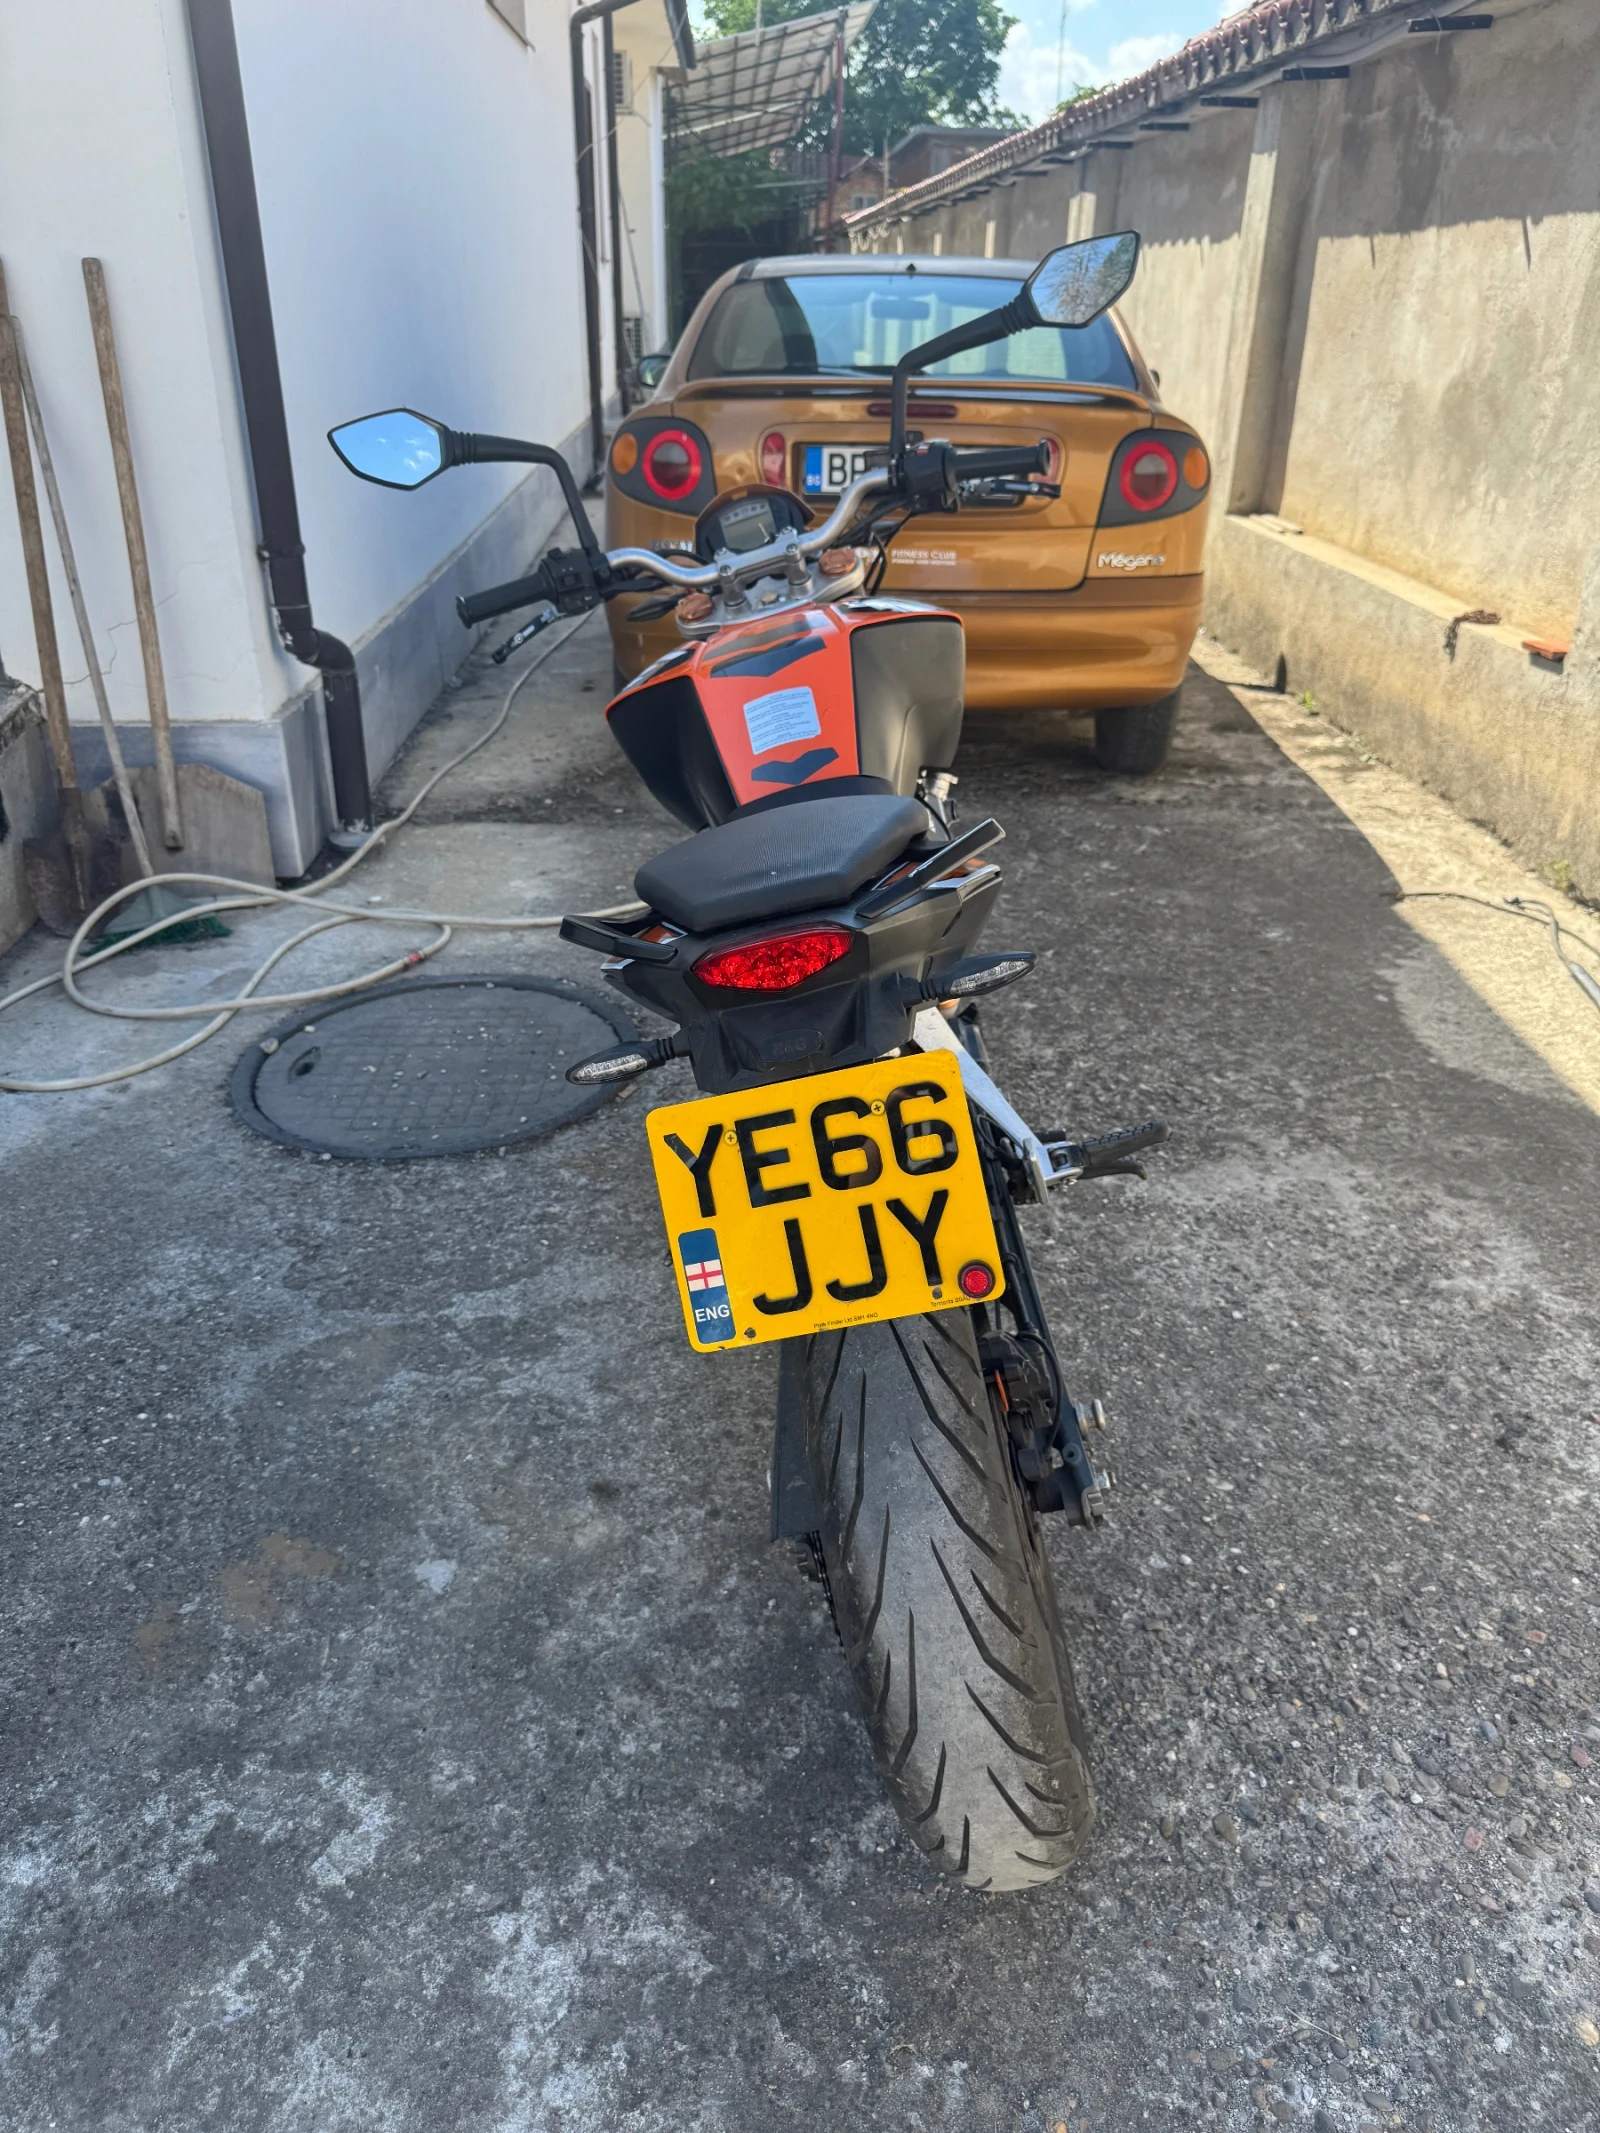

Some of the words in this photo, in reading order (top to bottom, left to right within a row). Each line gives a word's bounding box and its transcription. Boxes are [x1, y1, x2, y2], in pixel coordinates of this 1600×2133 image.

[806, 475, 821, 486] BG
[891, 549, 928, 559] FITNESS
[930, 550, 956, 559] CLUB
[663, 1081, 959, 1219] YE66
[752, 1189, 950, 1316] JJY
[695, 1304, 730, 1322] ENG
